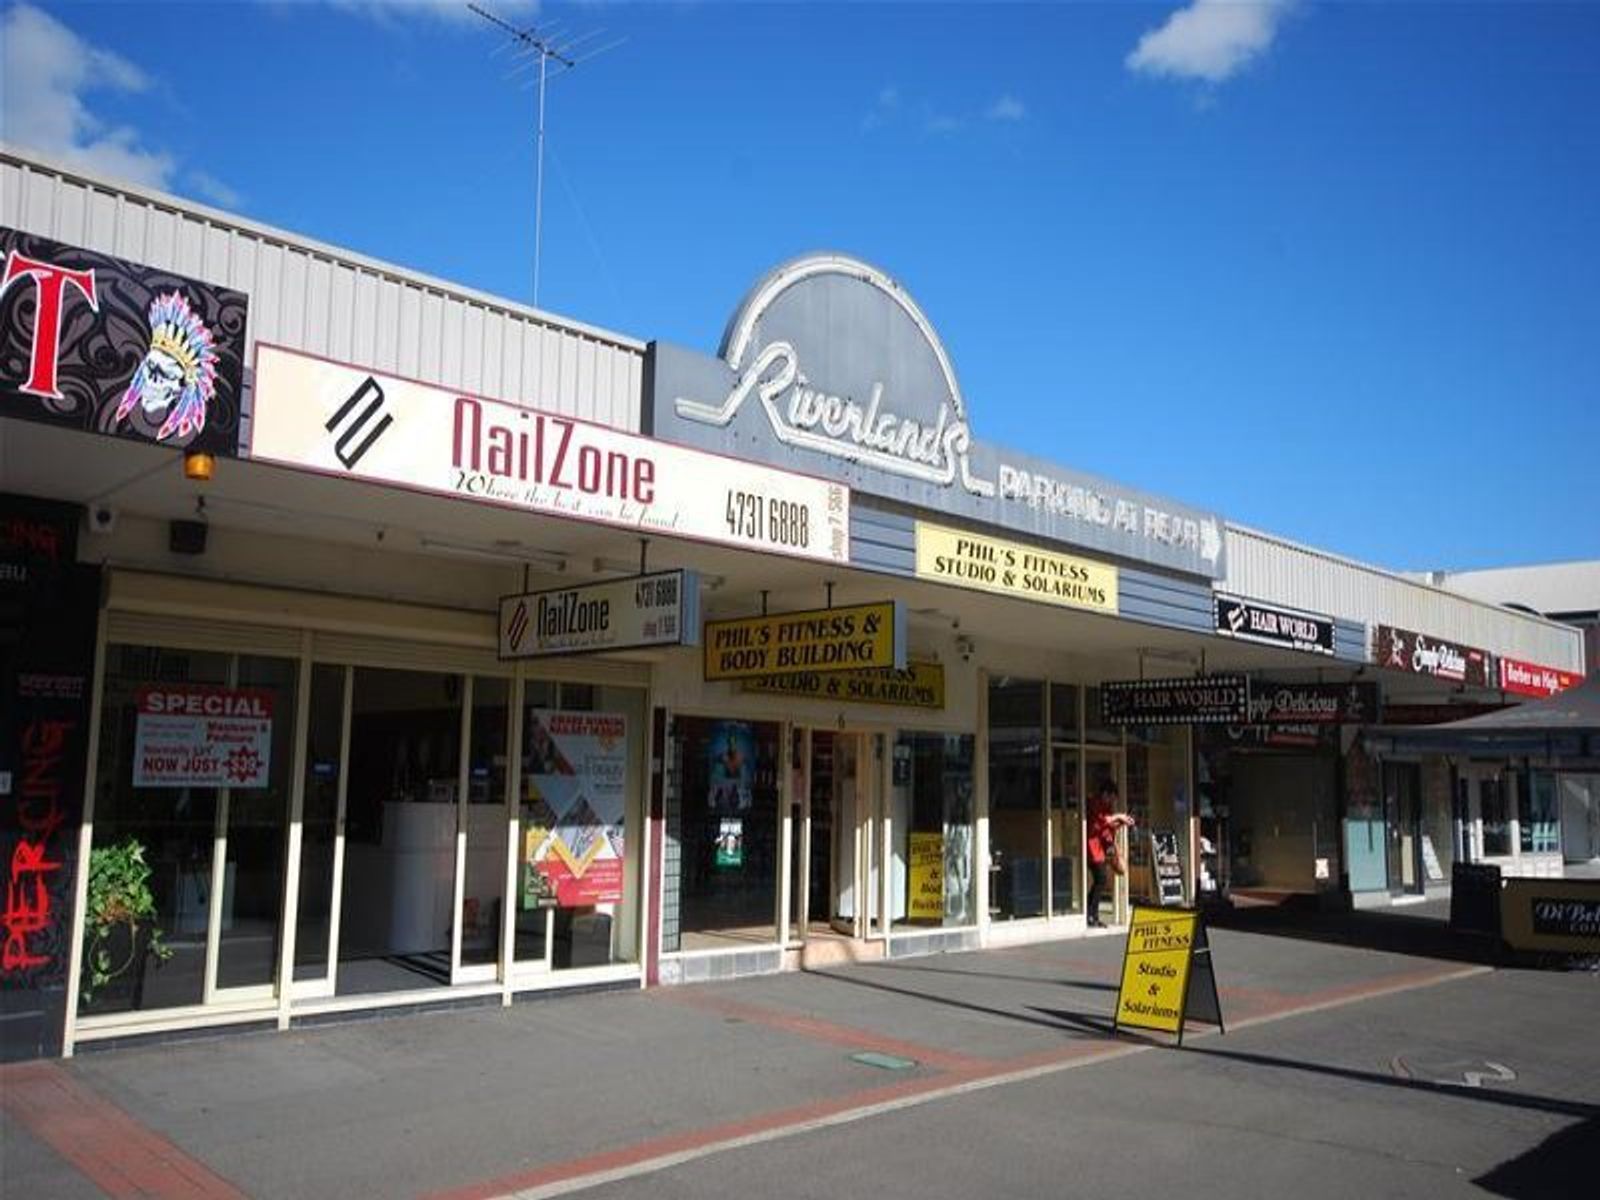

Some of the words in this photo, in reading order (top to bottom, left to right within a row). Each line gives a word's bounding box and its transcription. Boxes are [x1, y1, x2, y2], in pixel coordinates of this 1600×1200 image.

[0, 249, 99, 400] T
[452, 398, 655, 504] NailZone
[726, 489, 763, 540] 4731
[769, 498, 809, 549] 6888
[1000, 464, 1111, 526] PARKING
[1114, 500, 1137, 534] AT
[1144, 507, 1200, 550] REAR
[957, 540, 1016, 566] PHIL'S
[1023, 555, 1089, 582] FITNESS
[934, 556, 996, 582] STUDIO
[1002, 570, 1015, 587] &
[1023, 574, 1106, 604] SOLARIUMS
[538, 593, 609, 638] NailZone
[715, 623, 771, 649] PHIL'S
[778, 615, 855, 644] FITNESS
[863, 612, 881, 634] &
[1250, 610, 1279, 633] HAIR
[1278, 616, 1318, 641] WORLD
[719, 649, 769, 672] BODY
[776, 640, 873, 667] BUILDING
[757, 672, 819, 693] STUDIO
[827, 679, 841, 694] &
[848, 681, 935, 703] SOLARIUMS
[1134, 690, 1172, 708] HAIR
[1174, 688, 1236, 706] WORLD
[1274, 690, 1338, 712] Delicious
[146, 692, 267, 716] SPECIAL
[142, 756, 179, 772] NOW
[181, 756, 220, 773] JUST
[1143, 935, 1190, 949] FITNESS
[1137, 962, 1177, 978] Studio
[1148, 982, 1160, 996] &
[1123, 1001, 1178, 1018] Solariums
